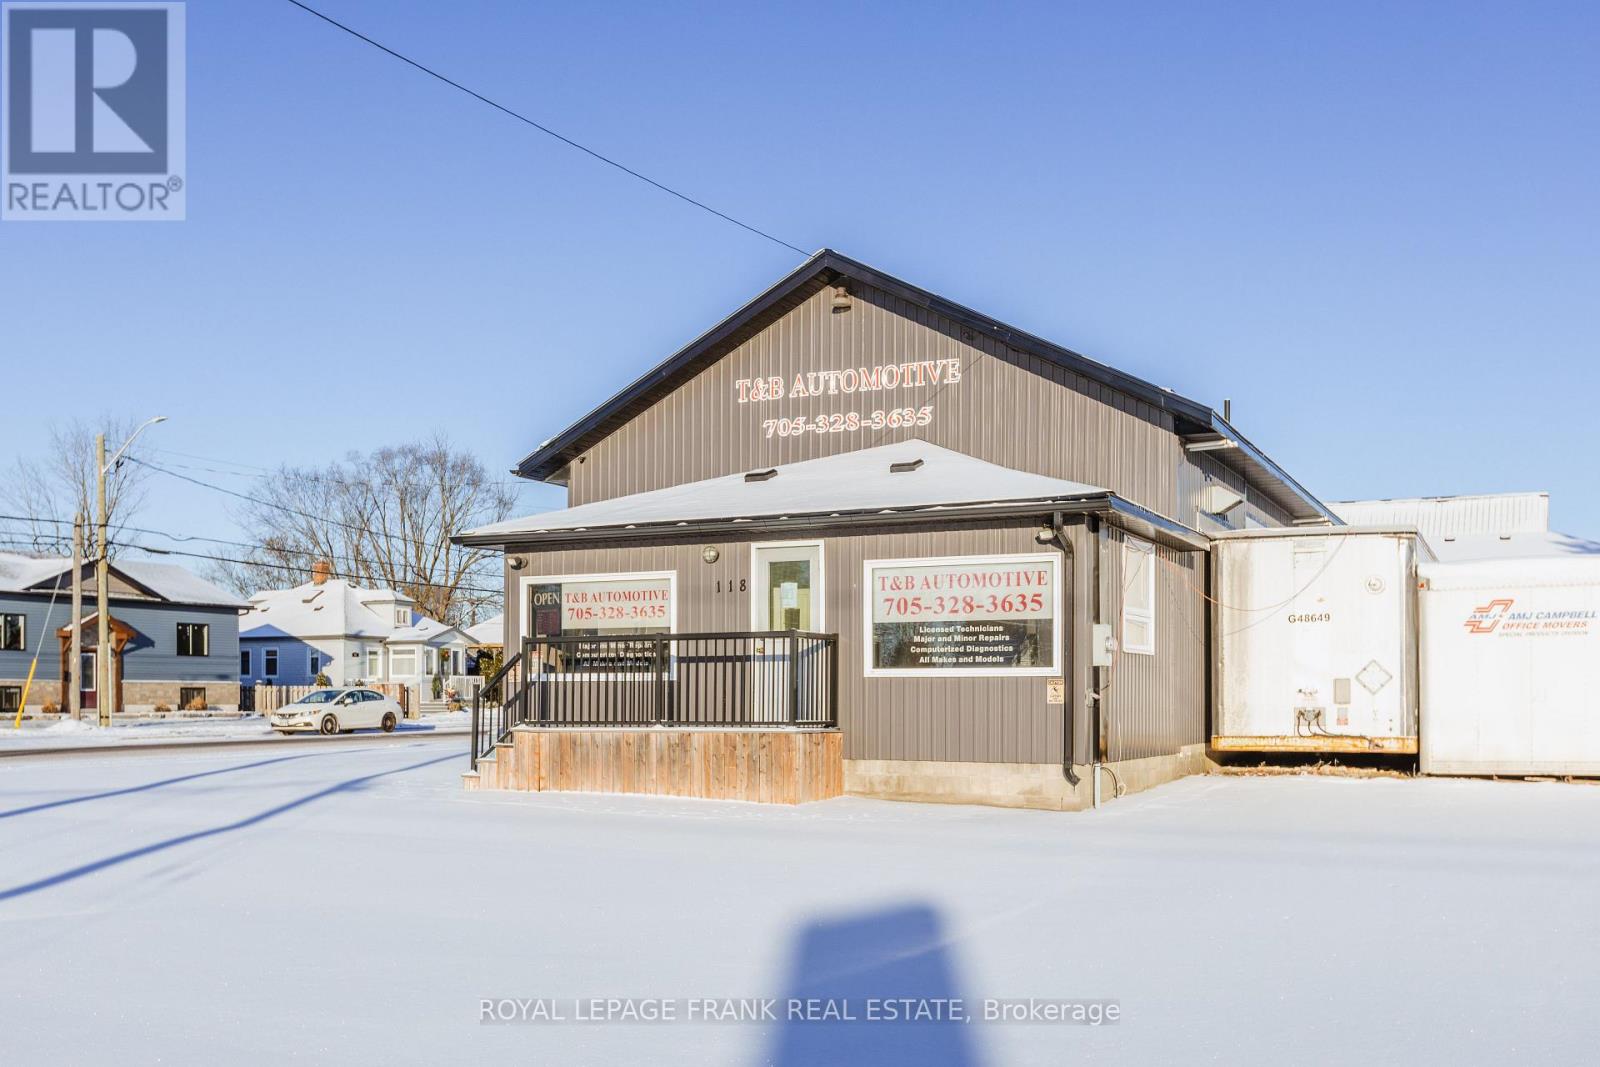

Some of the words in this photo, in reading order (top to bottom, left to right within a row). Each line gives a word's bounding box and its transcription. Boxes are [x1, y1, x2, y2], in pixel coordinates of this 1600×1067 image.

[735, 376, 785, 403] T&B
[788, 358, 962, 398] AUTOMOTIVE
[762, 406, 934, 438] 705-328-3635
[877, 575, 915, 591] T&B
[920, 570, 1048, 590] AUTOMOTIVE
[534, 592, 560, 606] OPEN
[565, 592, 588, 604] T&B
[591, 589, 669, 603] AUTOMOTIVE
[883, 593, 1044, 616] 705-328-3635
[568, 605, 665, 620] 705-328-3635
[1288, 612, 1331, 624] G48649
[1508, 612, 1533, 620] AMJ
[1536, 611, 1597, 620] CAMPBELL
[956, 624, 1004, 632] Technicians
[1502, 622, 1538, 630] OFFICE
[1542, 621, 1588, 629] MOVERS
[913, 635, 936, 643] Major
[954, 634, 977, 642] Minor
[978, 634, 1010, 643] Repairs
[910, 645, 965, 654] Computerized
[966, 644, 1014, 653] Diagnostics
[958, 655, 973, 663] and
[975, 655, 1004, 663] Models
